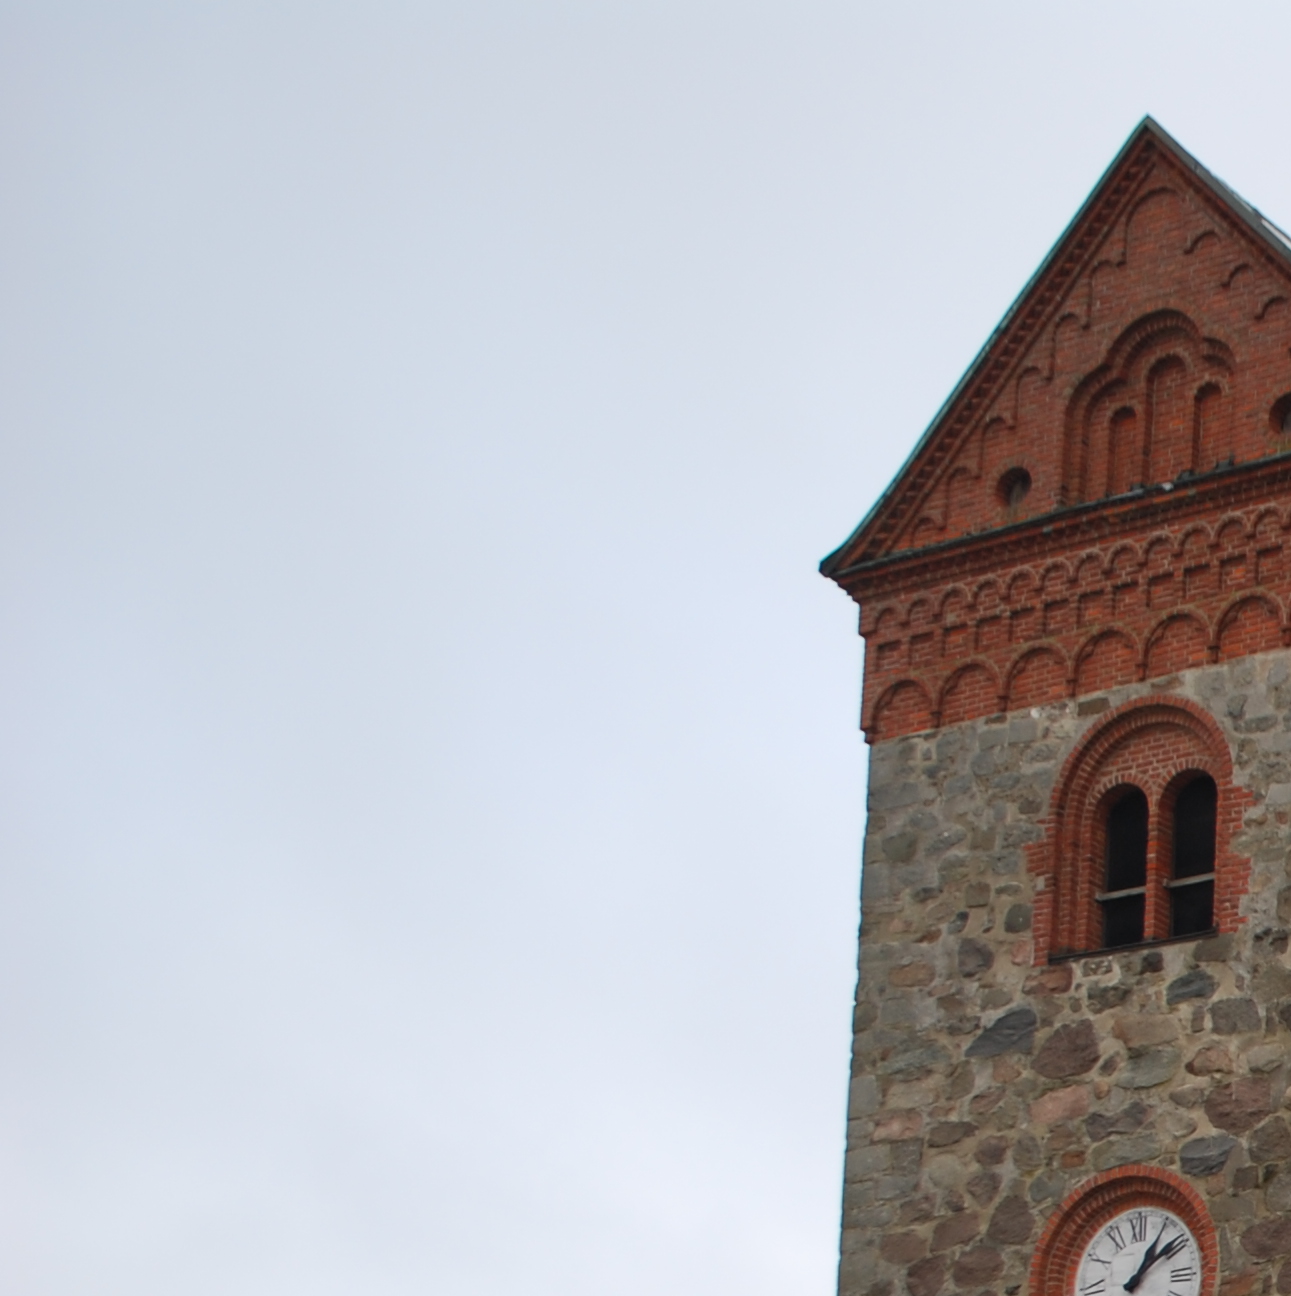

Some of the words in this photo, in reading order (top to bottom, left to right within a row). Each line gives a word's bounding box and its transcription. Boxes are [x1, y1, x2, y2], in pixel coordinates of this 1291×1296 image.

[1107, 1226, 1127, 1252] XI
[1129, 1216, 1147, 1244] XII
[1170, 1267, 1192, 1283] III
